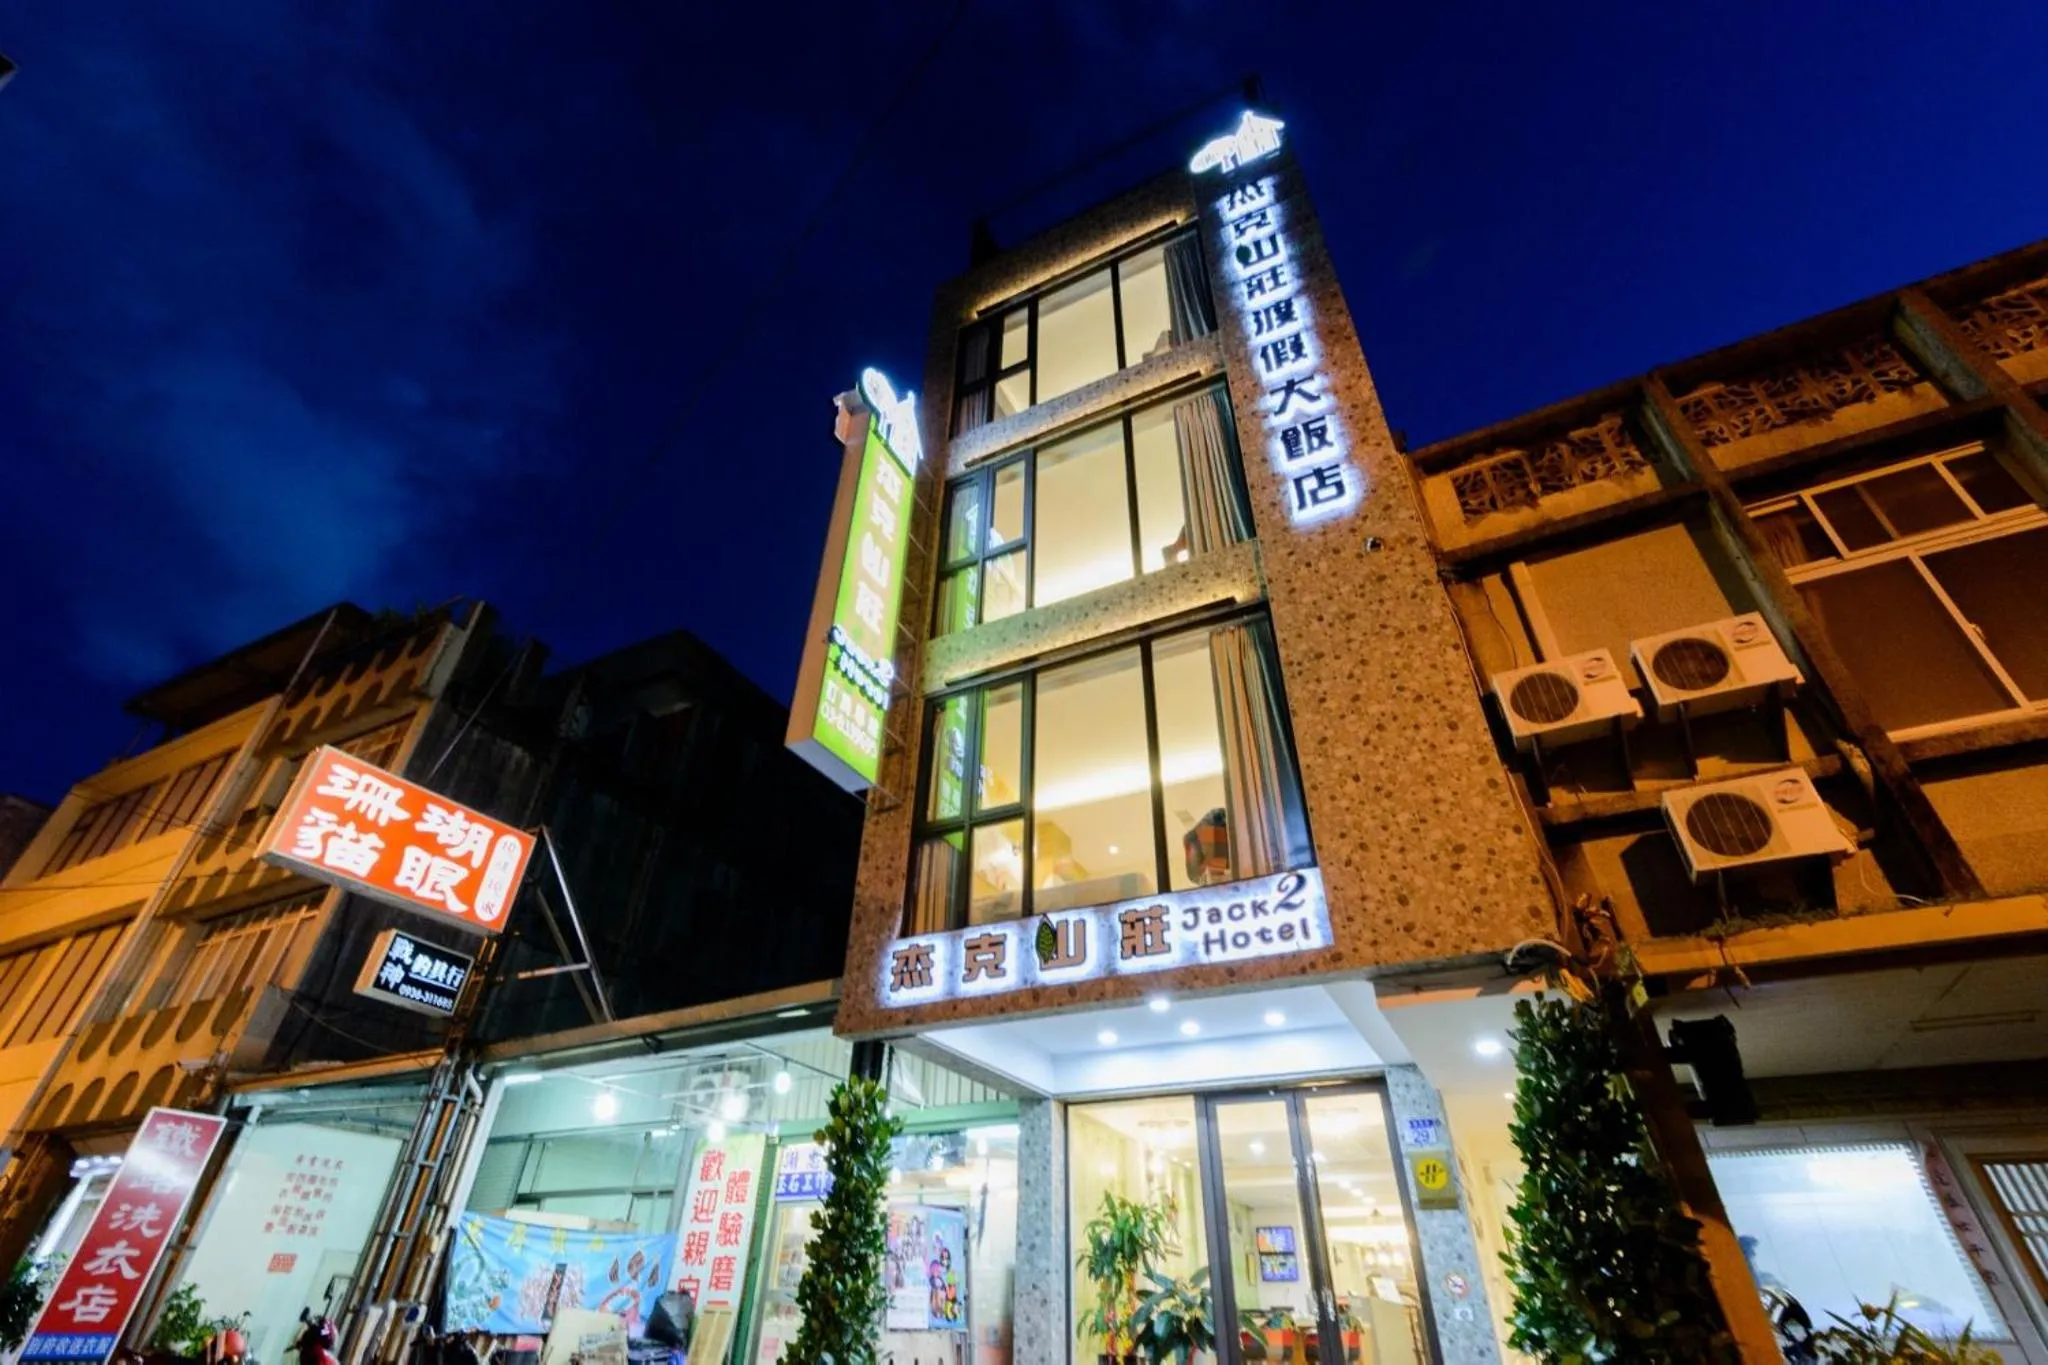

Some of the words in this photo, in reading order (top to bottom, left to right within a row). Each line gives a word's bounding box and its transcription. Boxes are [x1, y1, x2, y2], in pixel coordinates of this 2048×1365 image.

[292, 806, 469, 914] 貓眼
[316, 763, 495, 869] 珊瑚
[889, 904, 1171, 992] 杰克山莊
[1202, 917, 1311, 955] Hotel
[776, 1173, 835, 1194] 玉石工作
[707, 1170, 751, 1306] 體驗磨
